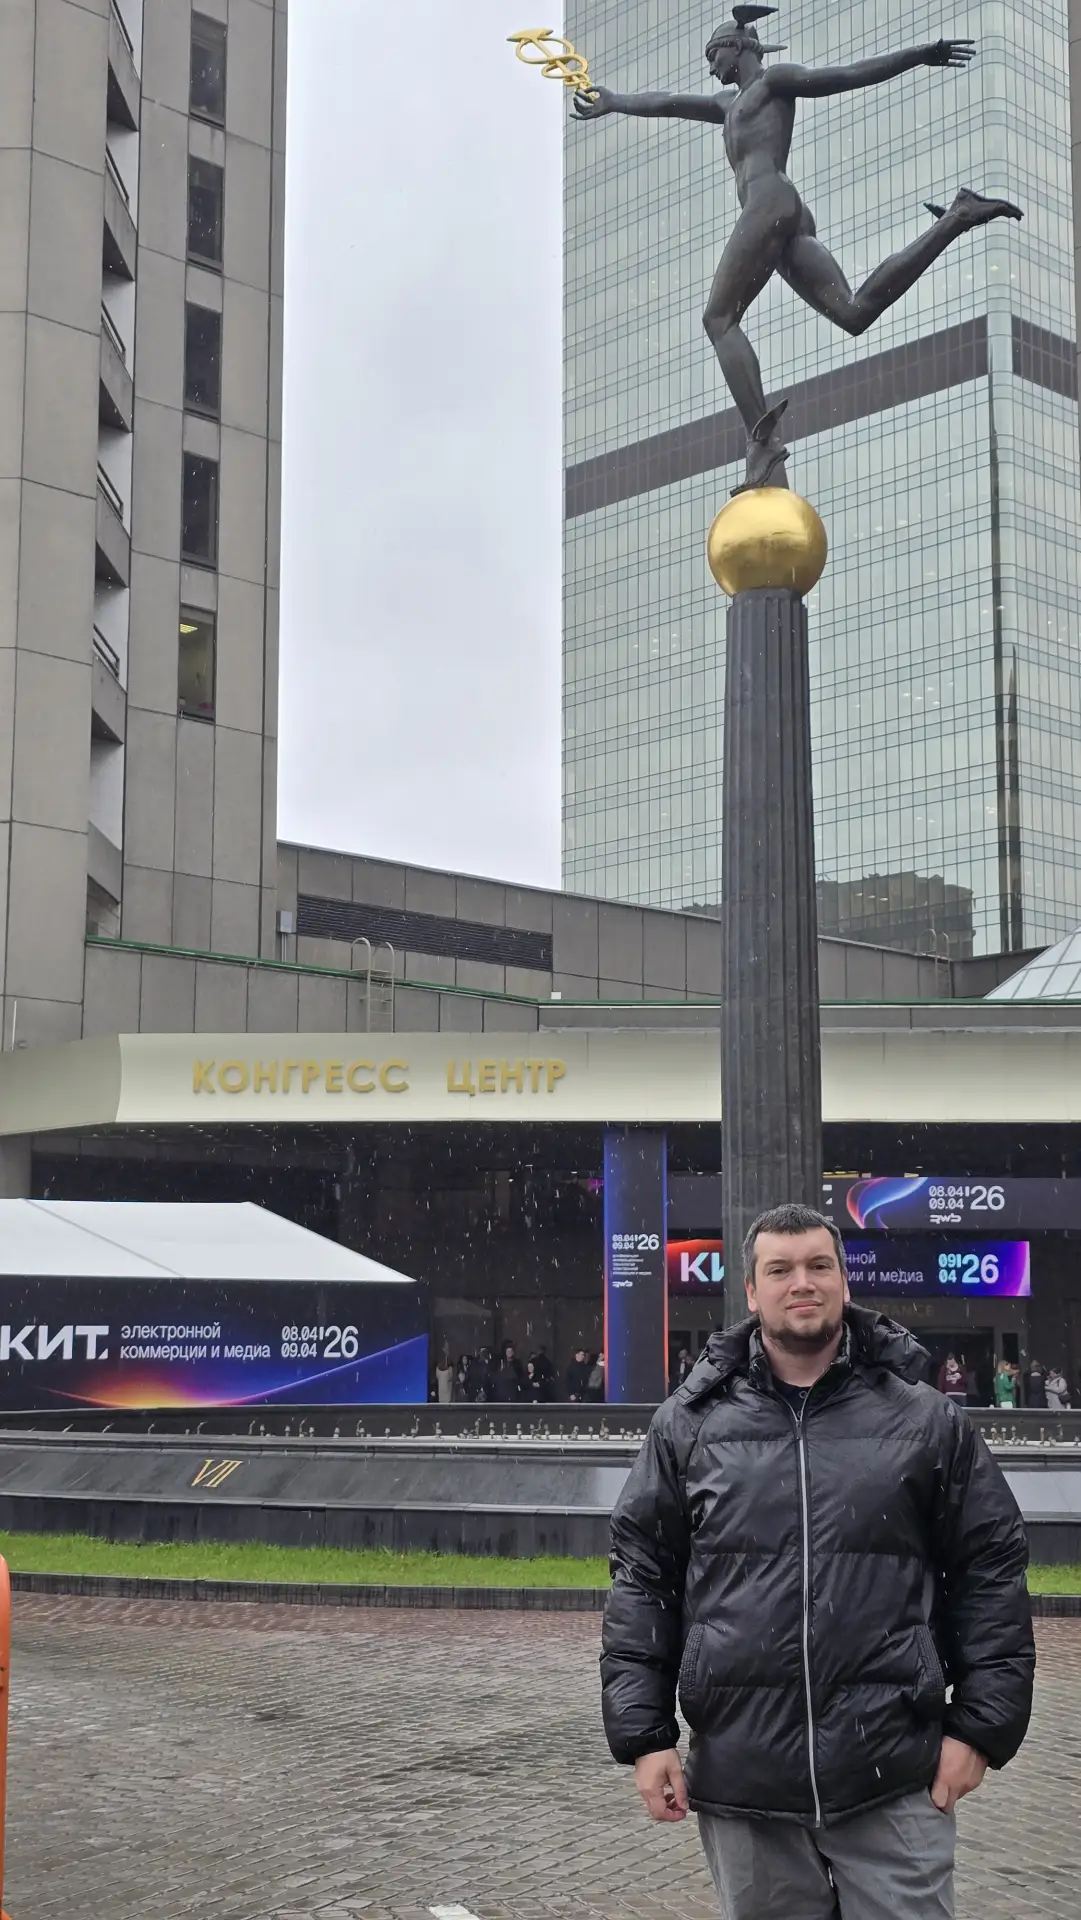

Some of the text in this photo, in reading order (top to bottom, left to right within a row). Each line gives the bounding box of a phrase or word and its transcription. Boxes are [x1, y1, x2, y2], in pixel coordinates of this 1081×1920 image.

[192, 1059, 568, 1097] КОНГРЕСС ЦЕНТР
[928, 1185, 964, 1197] 08.04
[928, 1198, 964, 1210] 09.04
[938, 1253, 956, 1268] 09
[867, 1270, 876, 1282] и
[879, 1270, 924, 1284] медиа
[938, 1269, 957, 1284] 04
[120, 1322, 221, 1341] электронной
[281, 1325, 318, 1341] 08.04
[120, 1344, 271, 1361] коммерции и медиа
[281, 1342, 318, 1358] 09.04
[191, 1459, 243, 1487] VII
